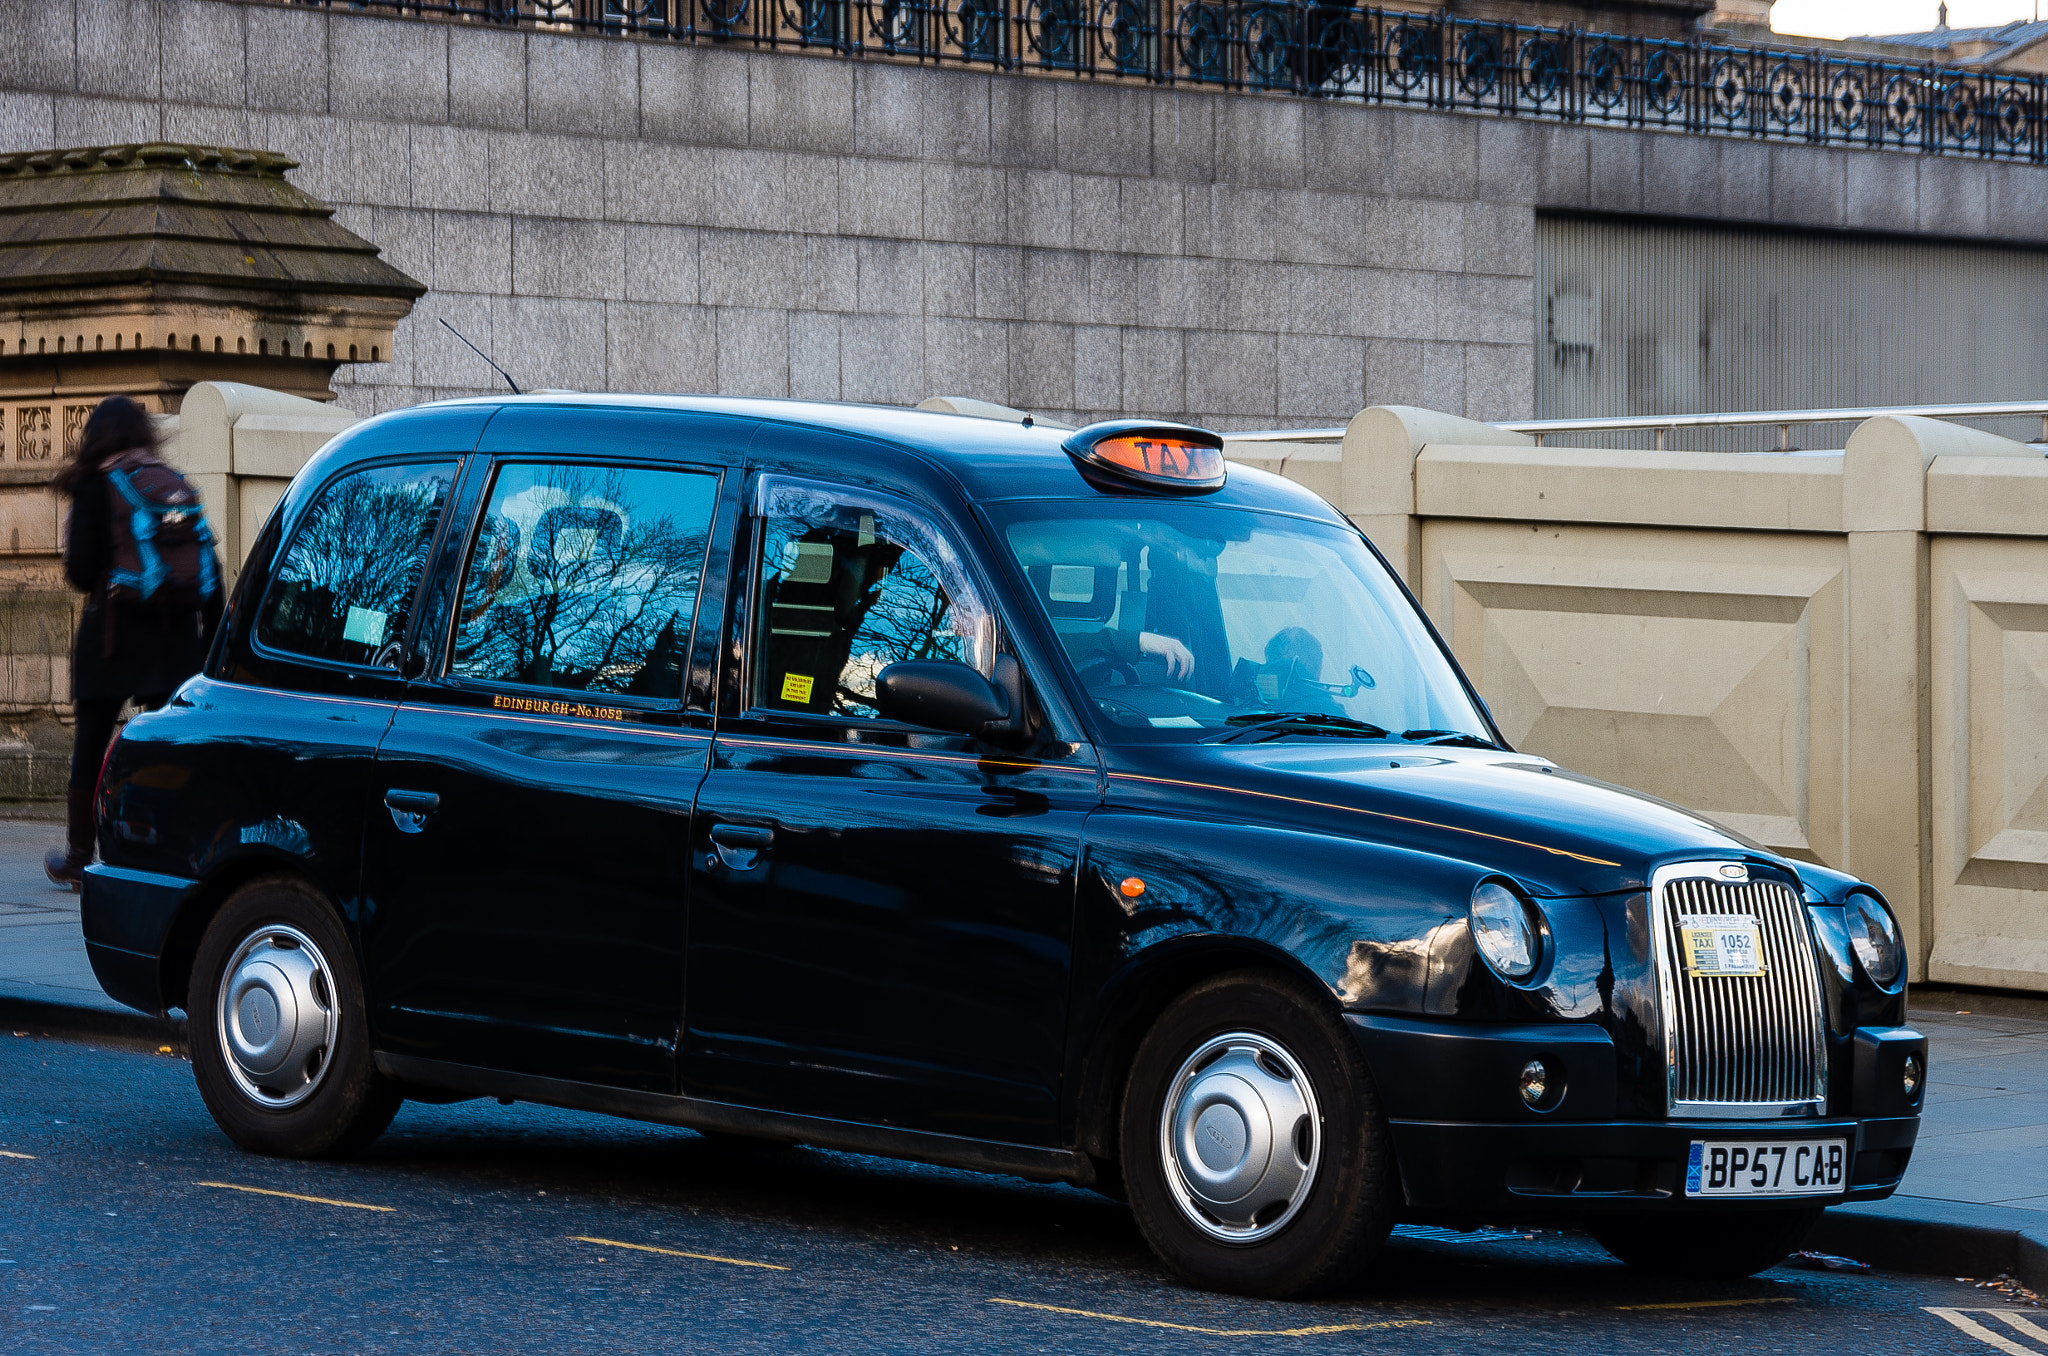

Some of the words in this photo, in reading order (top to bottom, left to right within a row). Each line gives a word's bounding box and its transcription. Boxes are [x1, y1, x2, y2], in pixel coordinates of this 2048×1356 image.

[1693, 938, 1714, 948] TAXI
[1720, 934, 1751, 949] 1052
[1708, 1146, 1788, 1189] BP57
[1795, 1144, 1843, 1187] CAB
